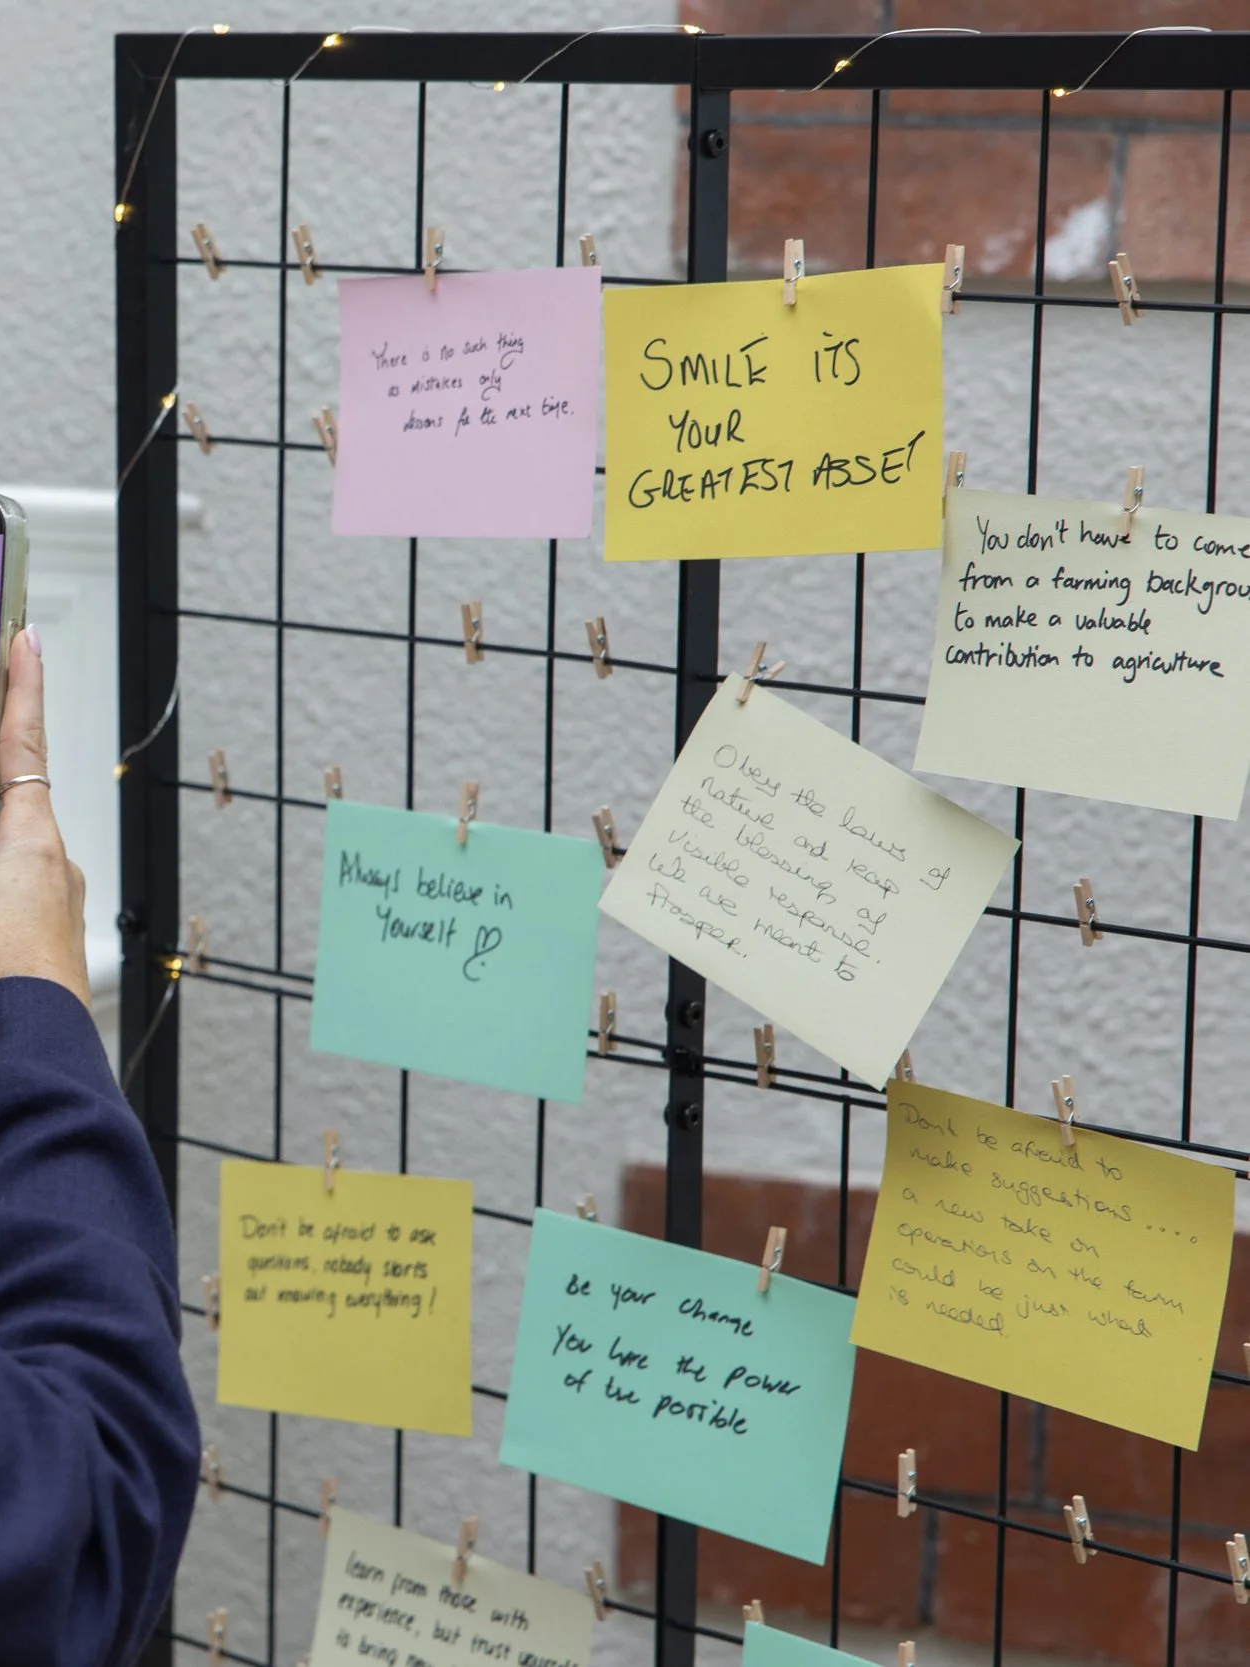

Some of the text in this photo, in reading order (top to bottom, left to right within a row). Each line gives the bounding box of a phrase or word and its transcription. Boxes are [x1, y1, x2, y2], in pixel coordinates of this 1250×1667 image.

[421, 344, 431, 362] is
[462, 336, 487, 355] such
[496, 332, 525, 370] thing
[640, 335, 768, 391] SMILE
[410, 375, 463, 394] mistakes
[479, 368, 502, 401] only
[506, 404, 531, 420] next
[668, 409, 745, 453] YOUR
[628, 430, 926, 509] GREATEST ASSET
[976, 515, 1250, 559] You don't have to come
[958, 561, 1250, 615] from a farming backgrou
[954, 601, 1152, 636] to make a valuable
[1072, 644, 1094, 668] to
[1112, 649, 1225, 684] agriculture
[713, 744, 782, 798] Obey
[790, 787, 826, 818] the
[919, 865, 952, 891] of
[680, 795, 887, 936] the blessing of
[793, 834, 830, 862] and
[339, 849, 514, 911] Always believe in
[375, 903, 457, 948] Yourself
[698, 885, 738, 917] are
[753, 917, 822, 964] meant
[834, 953, 856, 983] to
[909, 1147, 973, 1178] make
[976, 1125, 999, 1151] be
[1011, 1140, 1085, 1172] afraid
[1096, 1156, 1124, 1181] to
[322, 1221, 376, 1244] afraid
[902, 1186, 1101, 1259] a new take on
[897, 1222, 1013, 1267] operations
[1027, 1258, 1057, 1280] on
[1067, 1266, 1103, 1290] the
[610, 1281, 656, 1311] your
[888, 1285, 910, 1306] is
[892, 1257, 1153, 1338] could be just what
[552, 1323, 593, 1357] You
[676, 1354, 707, 1383] the
[563, 1368, 594, 1394] of
[431, 1618, 463, 1646] but
[470, 1631, 512, 1661] trust
[490, 1608, 531, 1632] with
